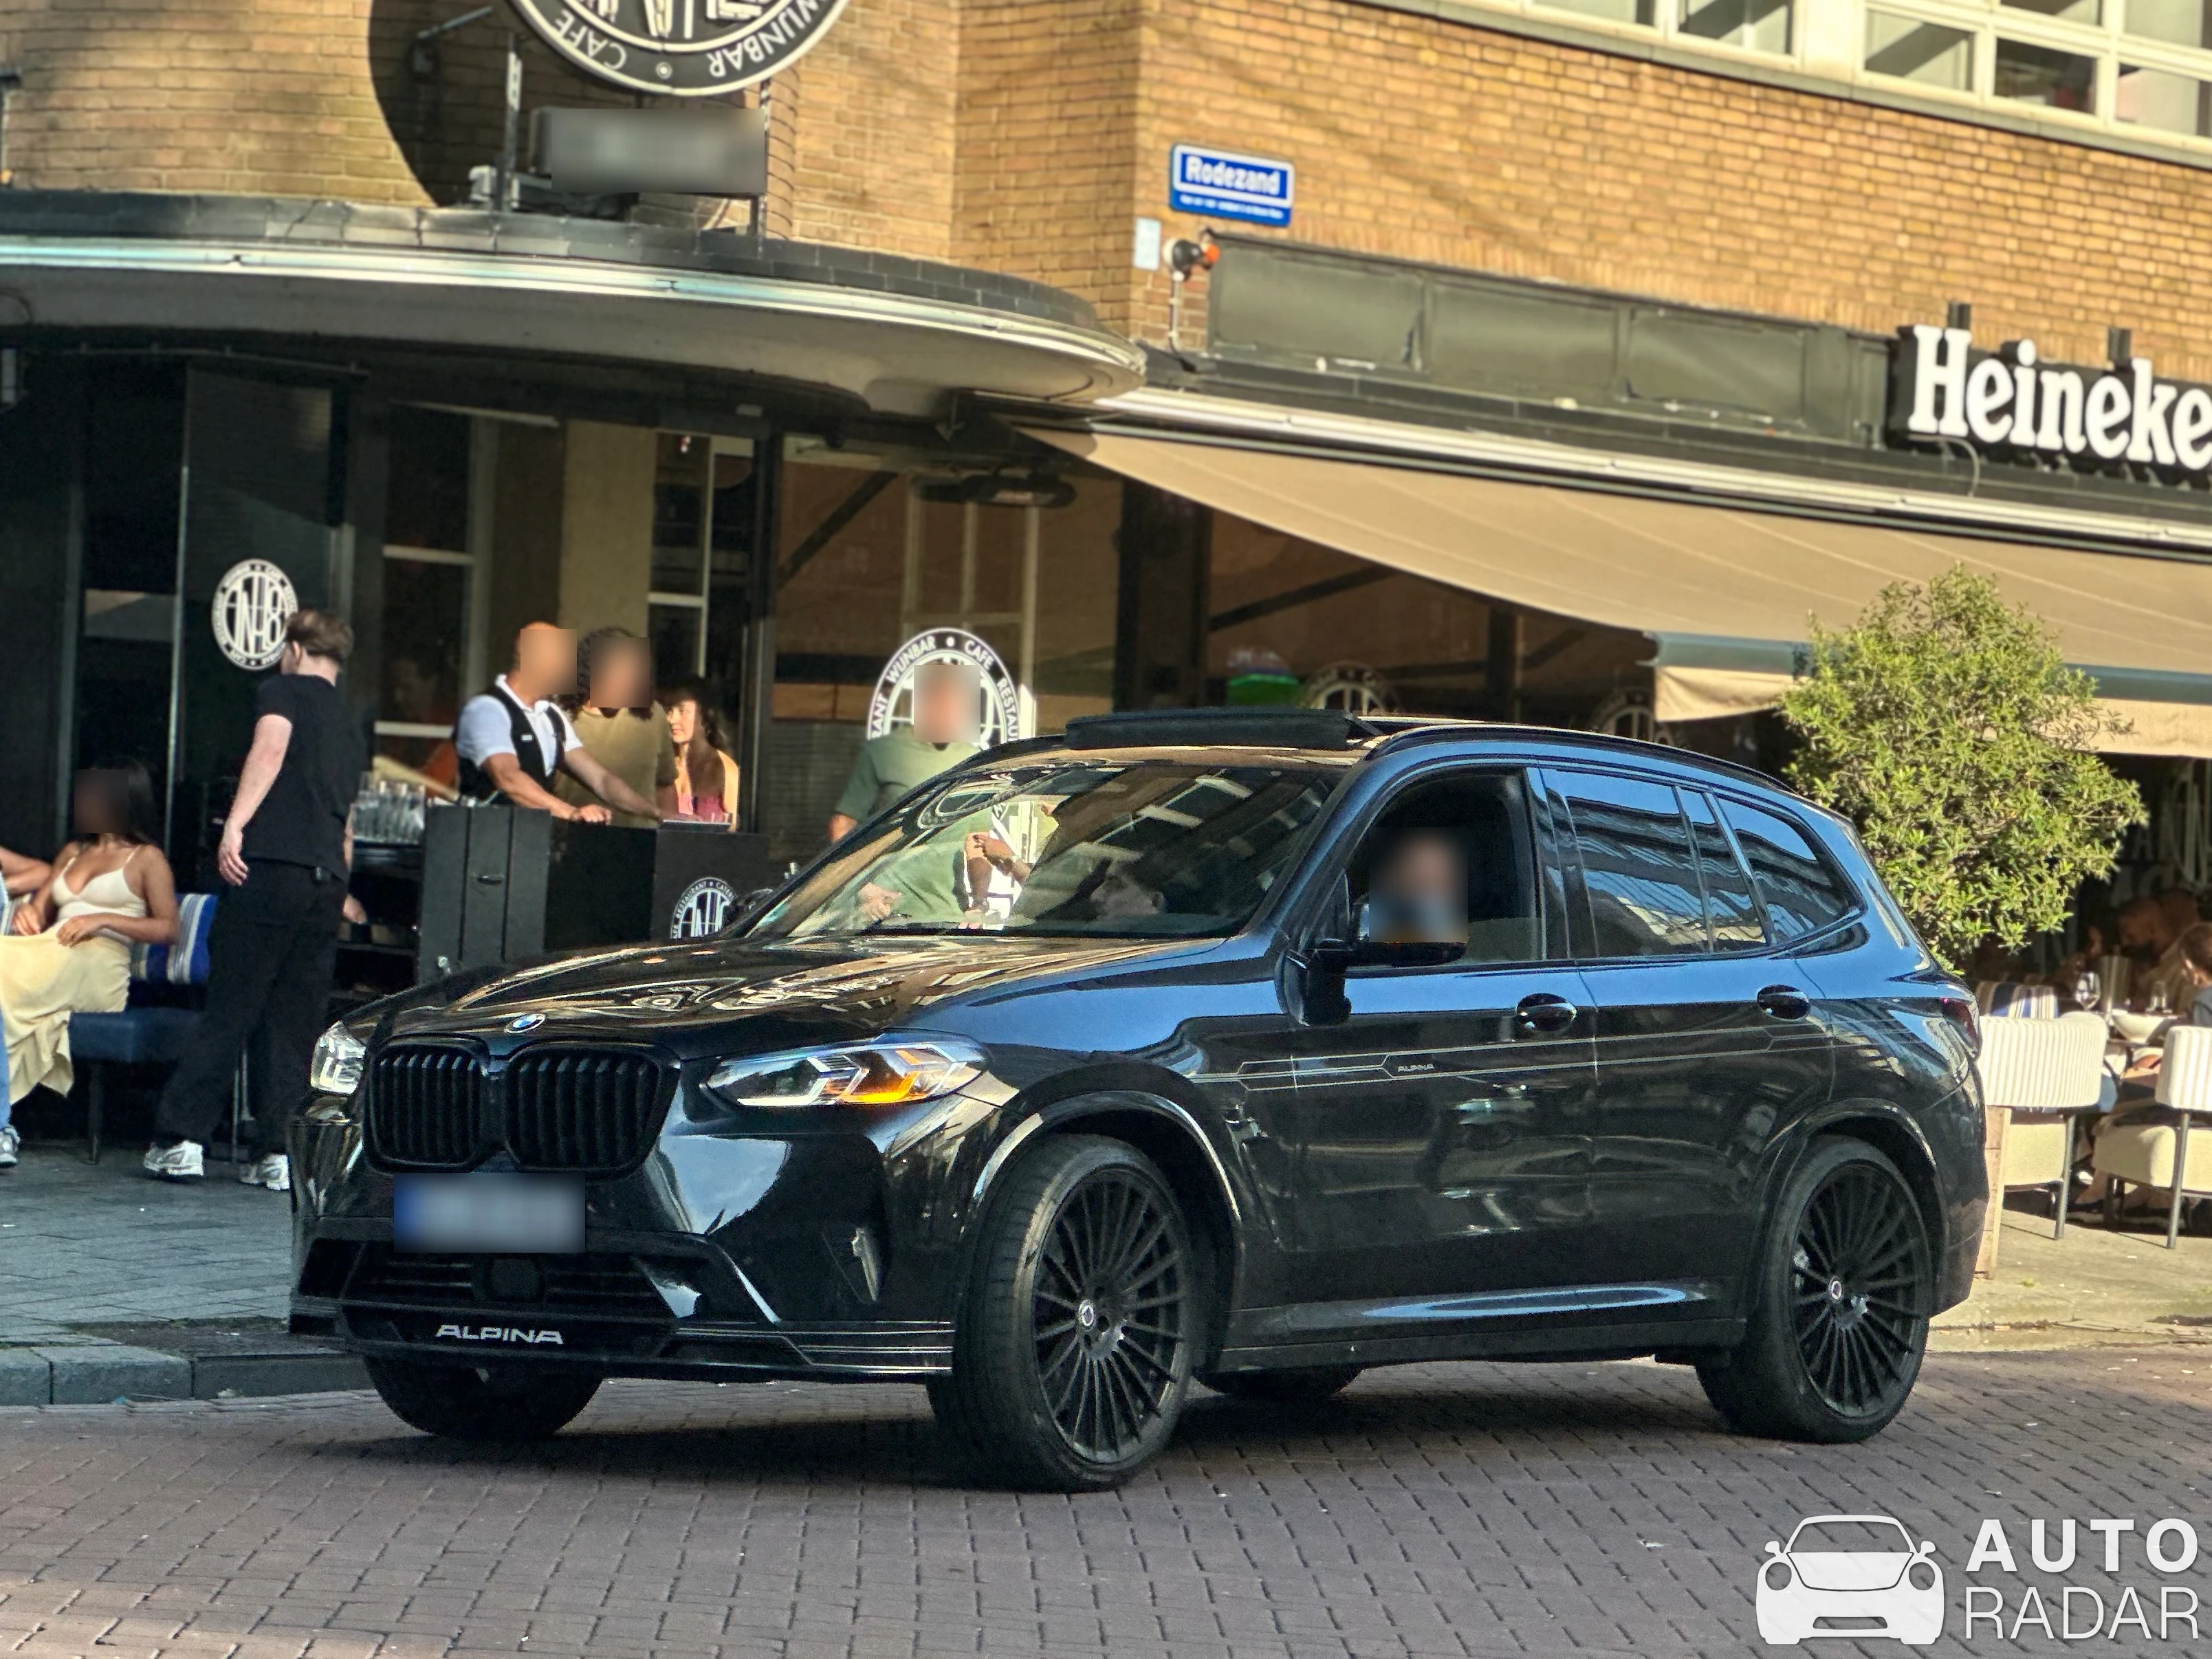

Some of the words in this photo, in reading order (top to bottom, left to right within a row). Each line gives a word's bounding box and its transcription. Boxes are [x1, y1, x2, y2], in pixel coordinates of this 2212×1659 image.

[555, 8, 627, 70] CAFE
[1185, 155, 1281, 196] Rodezand
[1908, 324, 2212, 470] Heineke
[965, 640, 994, 670] CAFE
[996, 677, 1020, 741] RESTAU
[435, 1324, 564, 1345] ALPINA
